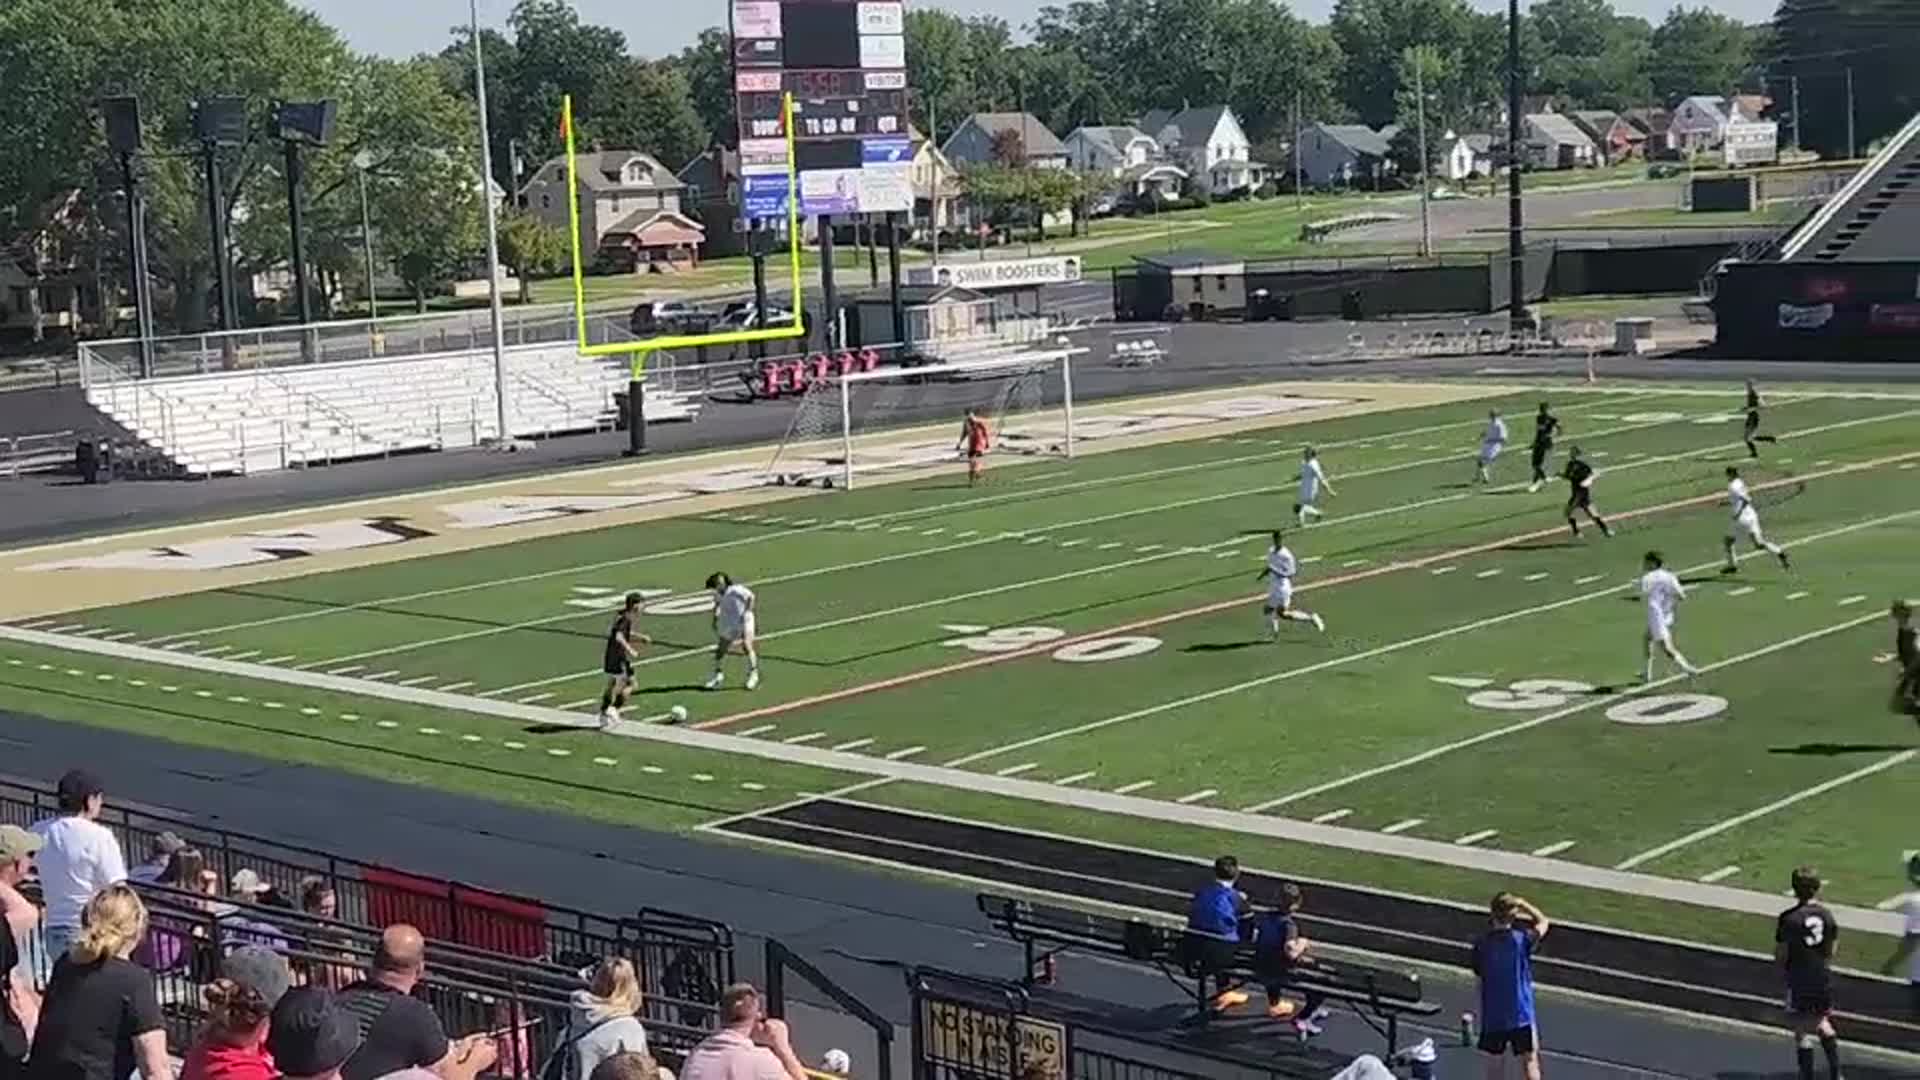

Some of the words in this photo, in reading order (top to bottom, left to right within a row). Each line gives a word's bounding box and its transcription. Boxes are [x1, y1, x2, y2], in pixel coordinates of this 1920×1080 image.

[868, 74, 903, 86] VISITOR
[958, 268, 992, 283] SWIM
[997, 263, 1060, 279] BOOSTERS
[1803, 915, 1825, 946] 3
[930, 1003, 958, 1031] NO
[962, 1015, 1055, 1054] STANDING
[980, 1043, 1031, 1067] AISE
